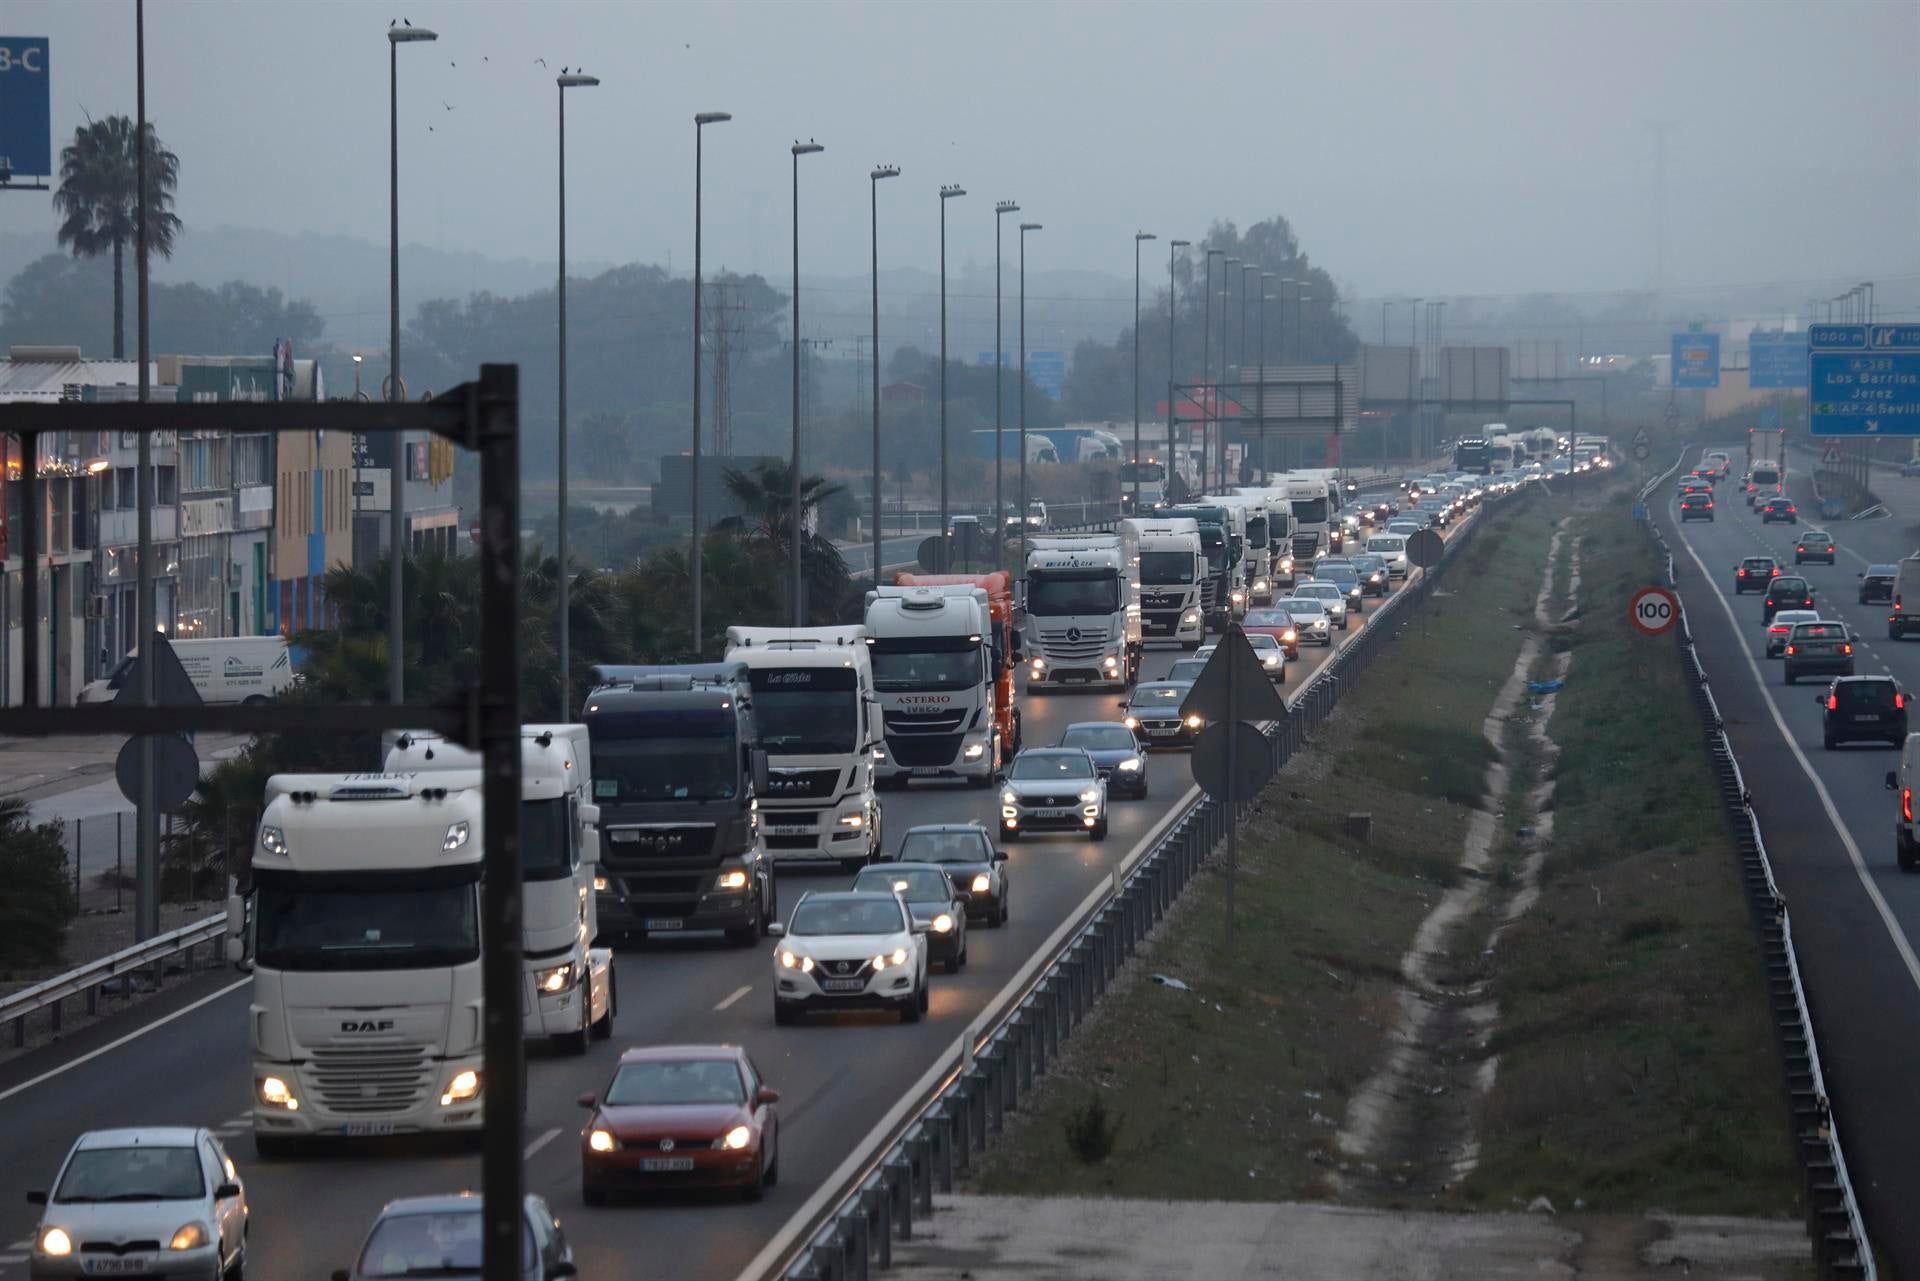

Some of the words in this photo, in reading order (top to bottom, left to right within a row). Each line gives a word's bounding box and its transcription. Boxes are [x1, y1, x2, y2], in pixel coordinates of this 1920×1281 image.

[1827, 373, 1854, 384] Los
[1860, 373, 1917, 384] Barrios
[1852, 388, 1894, 399] Jerez
[1637, 603, 1670, 618] 100
[896, 696, 951, 704] ASTERIO
[768, 781, 811, 790] MAN
[341, 1021, 394, 1032] DAF
